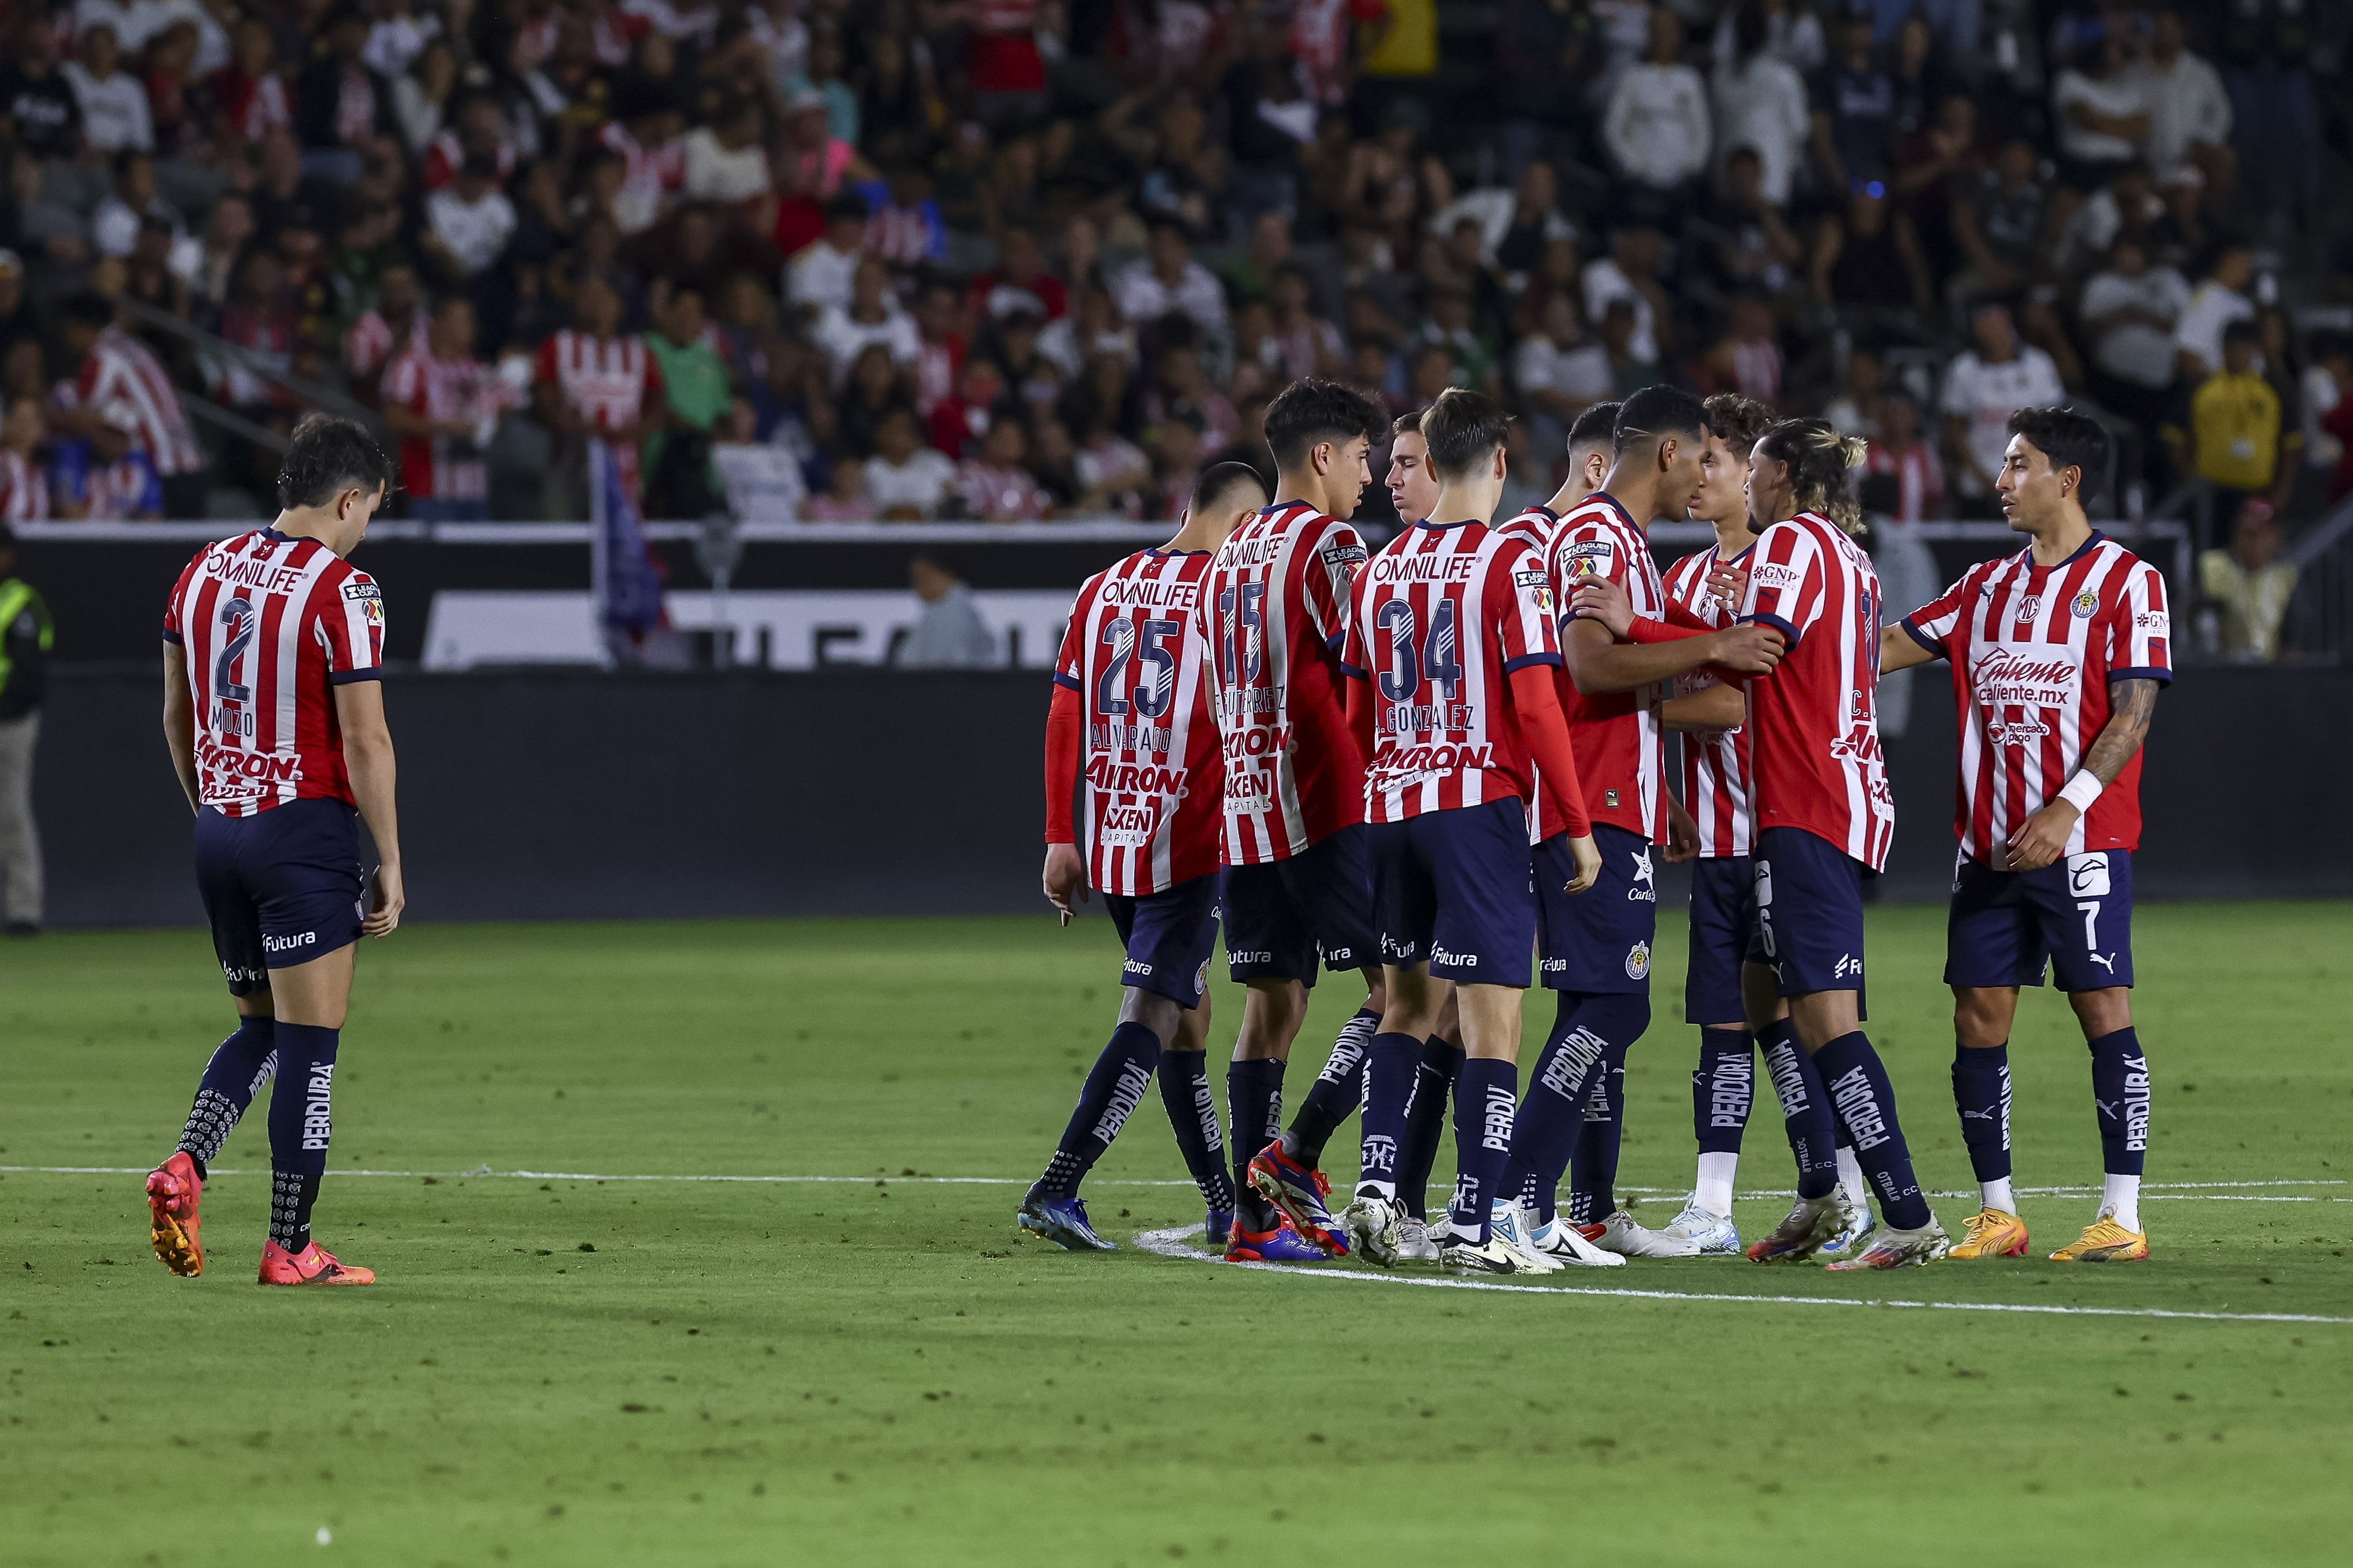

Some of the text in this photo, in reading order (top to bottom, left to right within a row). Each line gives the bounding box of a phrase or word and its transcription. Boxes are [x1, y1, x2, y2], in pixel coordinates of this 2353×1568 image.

[207, 553, 303, 592] OMNILIFE
[1218, 537, 1285, 568] OMNILIFE
[1374, 556, 1477, 581] OMNILIFE
[1765, 566, 1797, 582] GNP
[1102, 581, 1198, 608] OMNILIFE
[2017, 596, 2039, 621] MG
[1221, 581, 1264, 685] 15
[2150, 614, 2169, 624] GN
[215, 598, 254, 703] 2
[1098, 617, 1179, 718] 25
[1378, 599, 1461, 703] 34
[1972, 646, 2077, 688] Caliente
[1979, 683, 2069, 705] caliente.mx
[211, 706, 252, 736] MOZO
[1091, 724, 1172, 752] ALVARADO
[2008, 725, 2047, 734] mercado
[2008, 734, 2031, 743] pago
[1225, 773, 1268, 798] AXEN
[266, 932, 316, 952] Futura
[2077, 902, 2101, 950] 7
[1434, 946, 1477, 966] Futura
[1317, 1017, 1377, 1086] PERDURA
[1541, 1027, 1609, 1102] PERDURA
[1711, 1052, 1751, 1127] PERDURA
[1766, 1039, 1810, 1119] PERDURA
[302, 1063, 334, 1150] PERDURA
[1092, 1060, 1151, 1144] PERDURA
[1482, 1084, 1518, 1152] PERDU
[1831, 1065, 1891, 1151] PERDURA
[2127, 1056, 2151, 1151] PERDURA
